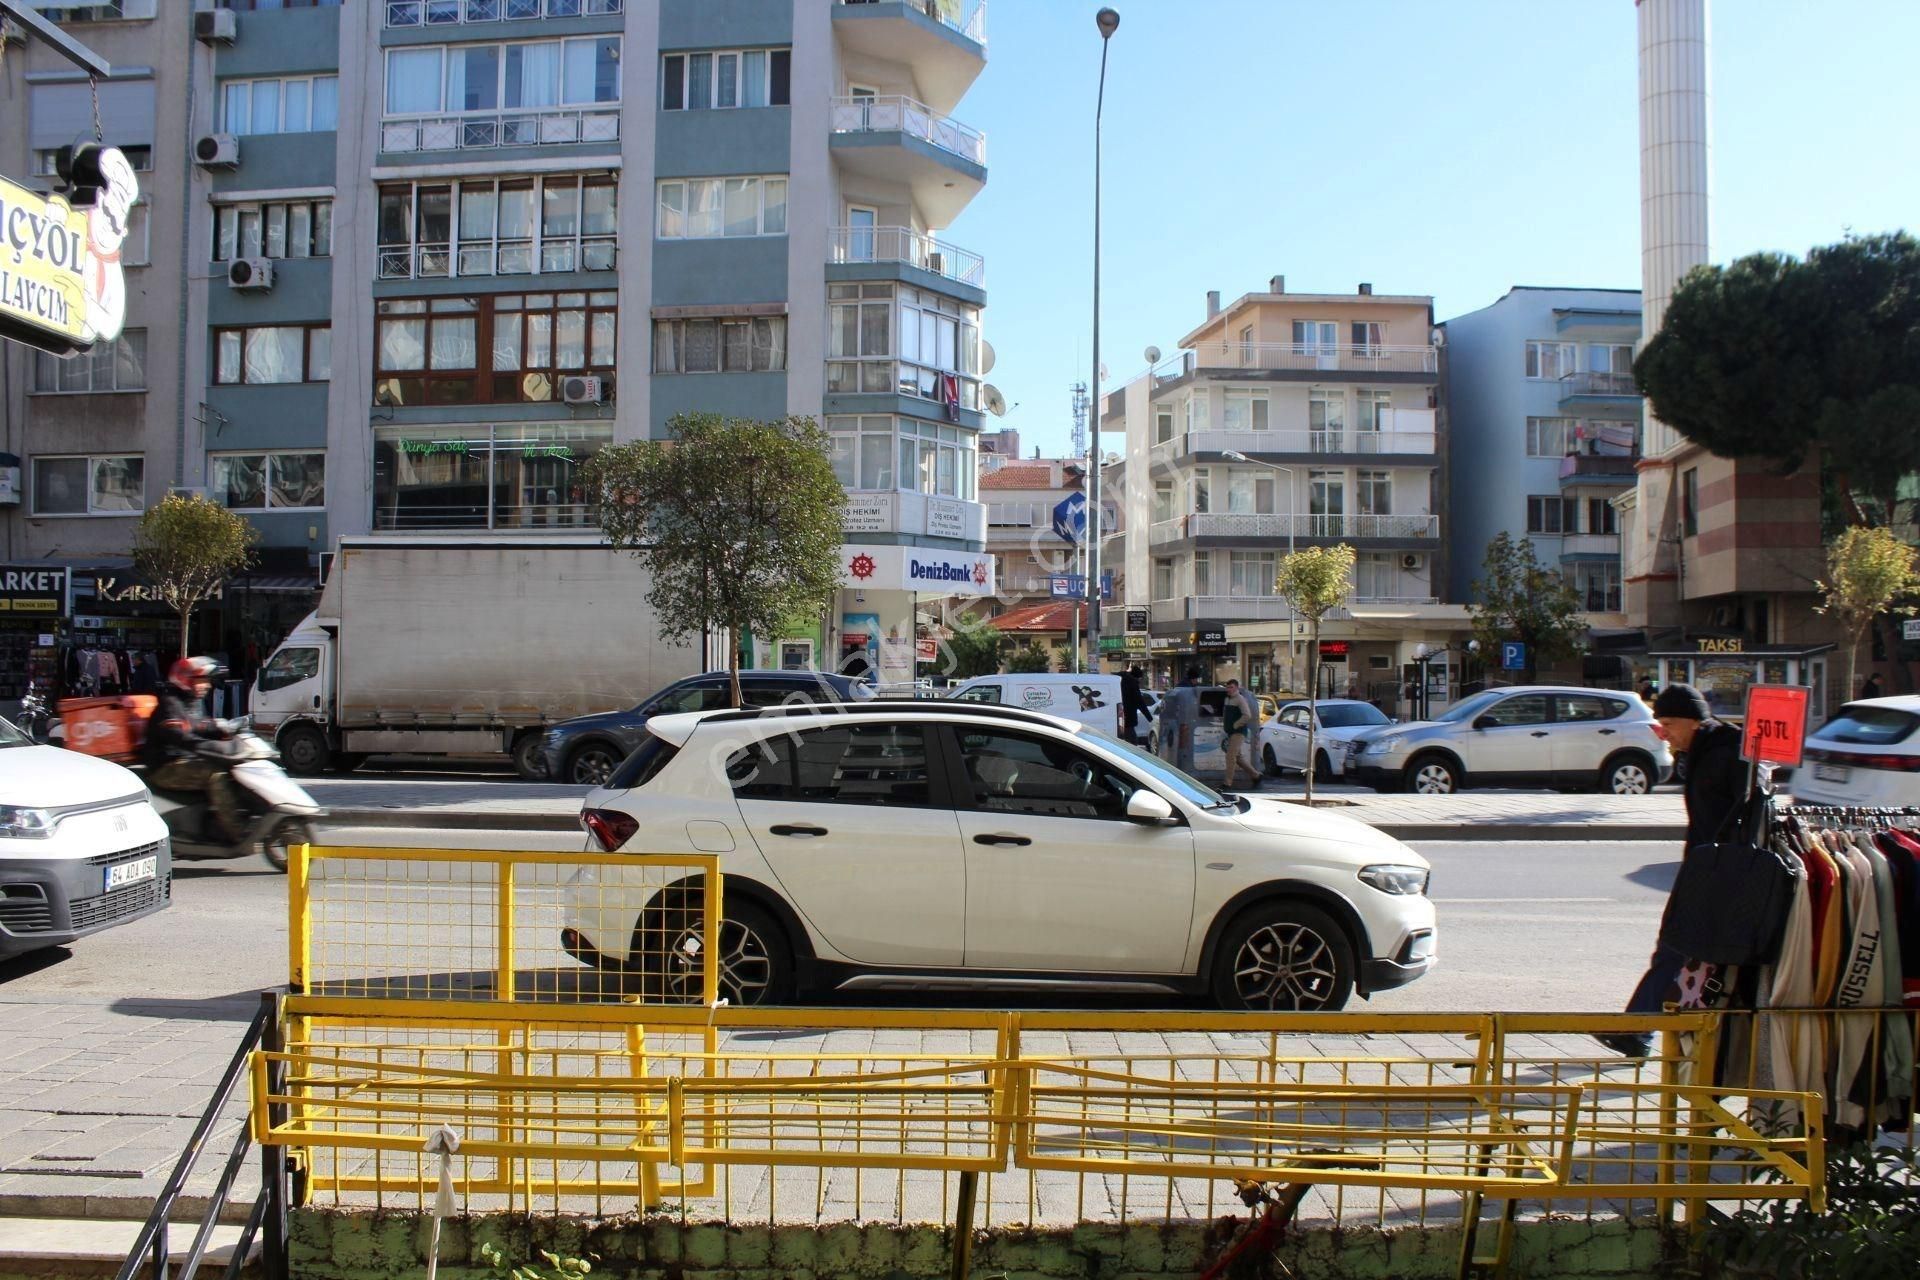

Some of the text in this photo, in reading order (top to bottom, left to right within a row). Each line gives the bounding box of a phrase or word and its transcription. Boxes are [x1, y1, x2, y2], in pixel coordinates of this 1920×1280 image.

[853, 508, 880, 516] HEKİMİ
[911, 559, 970, 582] DenizBank
[1506, 646, 1517, 666] P
[1757, 718, 1789, 740] 50 TL
[113, 867, 122, 883] 64
